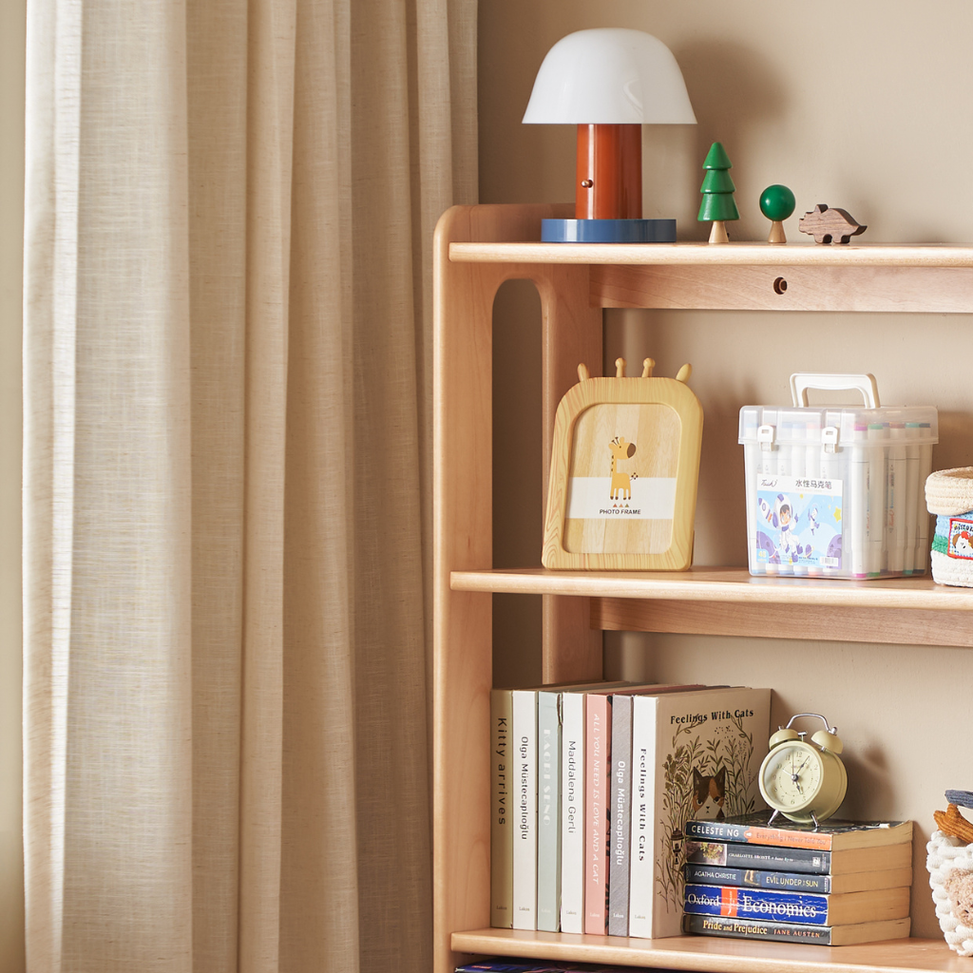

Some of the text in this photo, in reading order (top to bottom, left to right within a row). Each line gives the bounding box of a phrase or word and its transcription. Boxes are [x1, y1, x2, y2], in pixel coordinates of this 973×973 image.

[670, 709, 754, 725] Feelings With Cats
[519, 736, 528, 759] Olga
[497, 717, 508, 825] Kitty arrives
[592, 759, 600, 787] NEED
[616, 760, 625, 783] Olga
[568, 740, 577, 834] Maddalena Gerli
[592, 802, 600, 827] LOVE
[638, 748, 647, 862] Feelings With Cats
[691, 825, 739, 837] CELESTE NG
[715, 872, 736, 880] CHRISTIE
[766, 875, 779, 885] EVIL
[780, 877, 803, 887] UNDER
[688, 893, 720, 906] Oxford
[742, 895, 817, 917] Economics
[703, 920, 722, 931] Pride
[733, 923, 768, 935] Prejudice
[793, 930, 820, 938] AUSTEN
